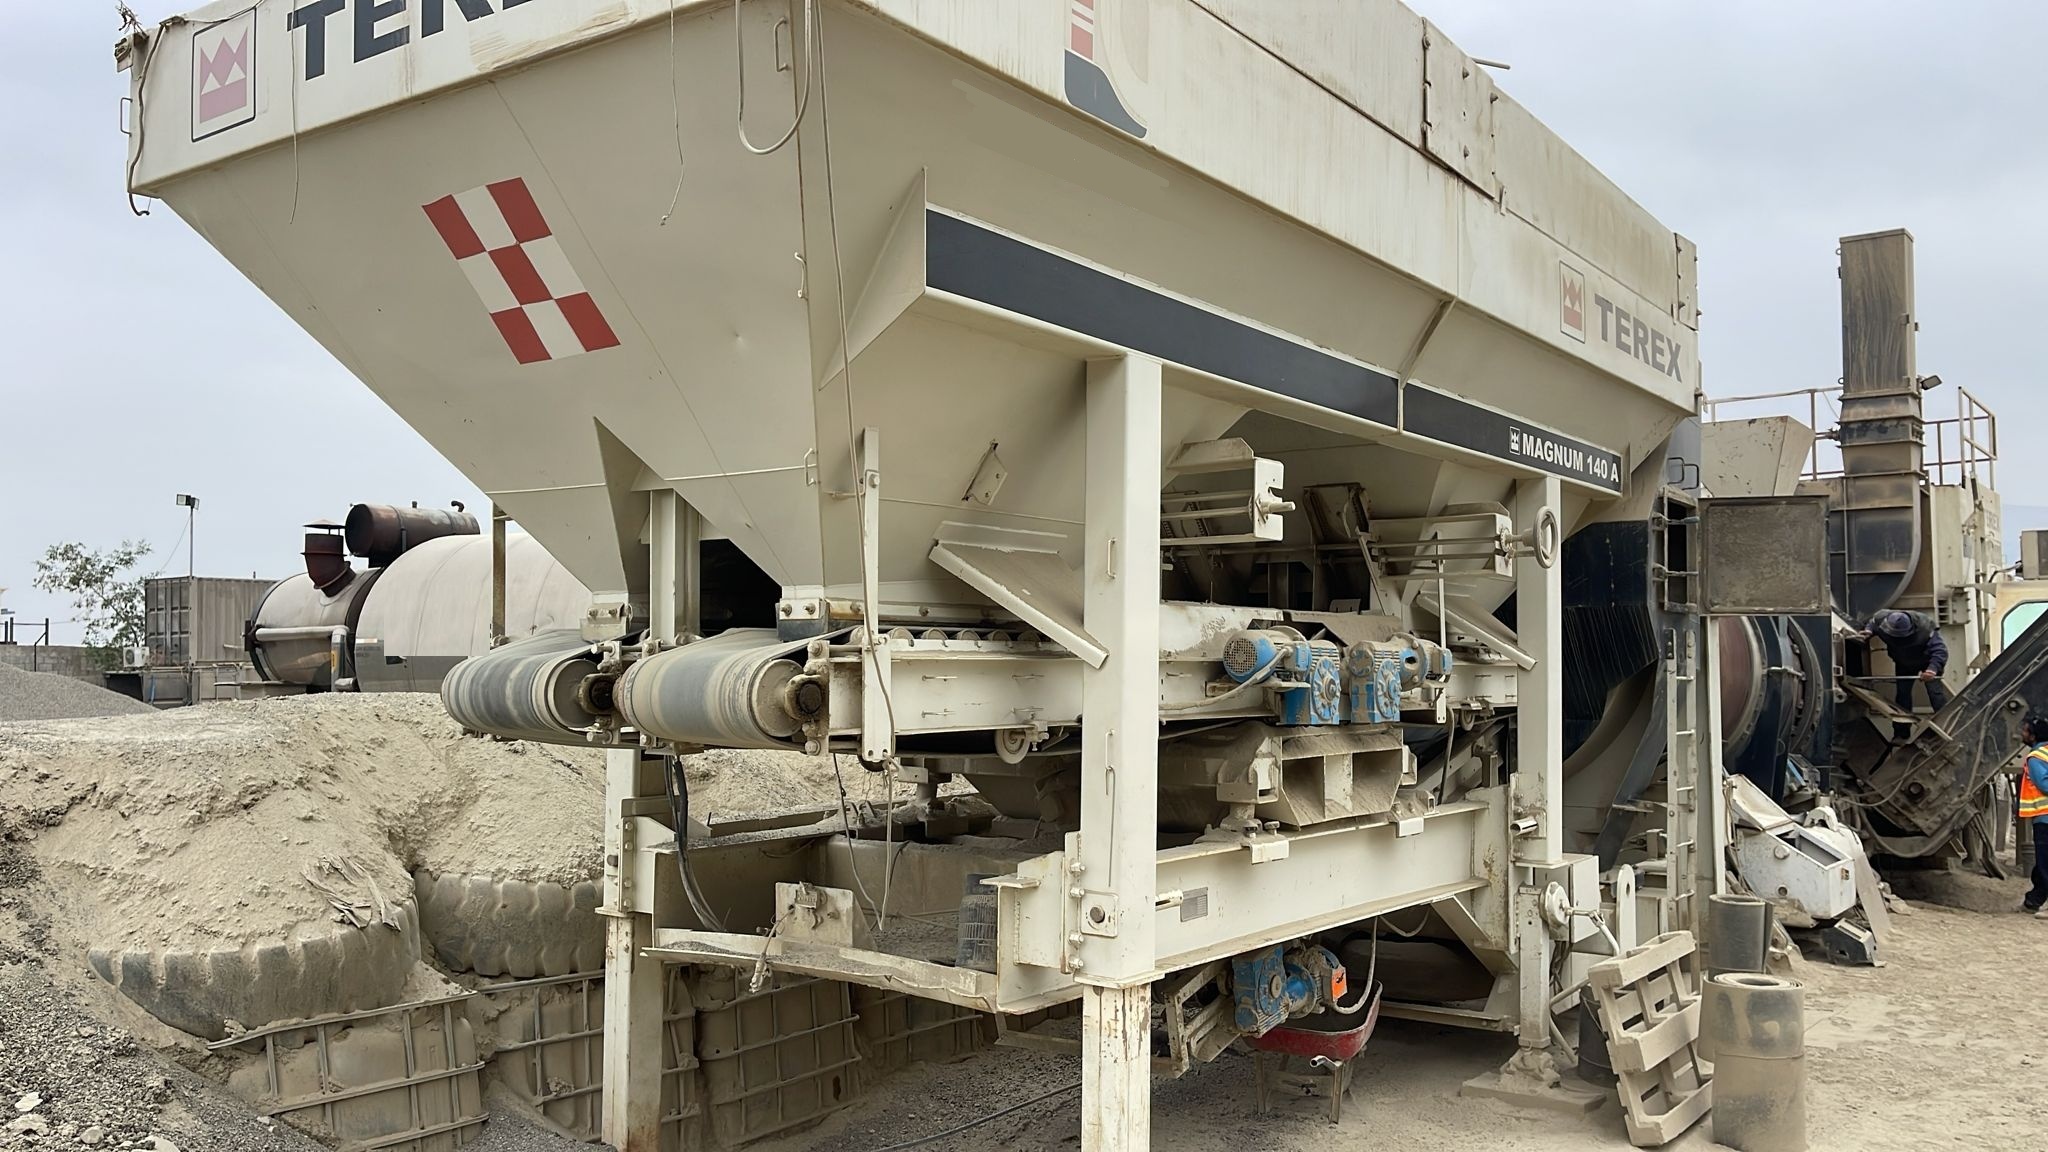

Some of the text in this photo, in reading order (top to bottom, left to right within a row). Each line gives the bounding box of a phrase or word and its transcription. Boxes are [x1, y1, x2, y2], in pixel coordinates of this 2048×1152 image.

[1594, 293, 1682, 383] TEREX
[1522, 433, 1619, 482] MAGNUM 140 A
